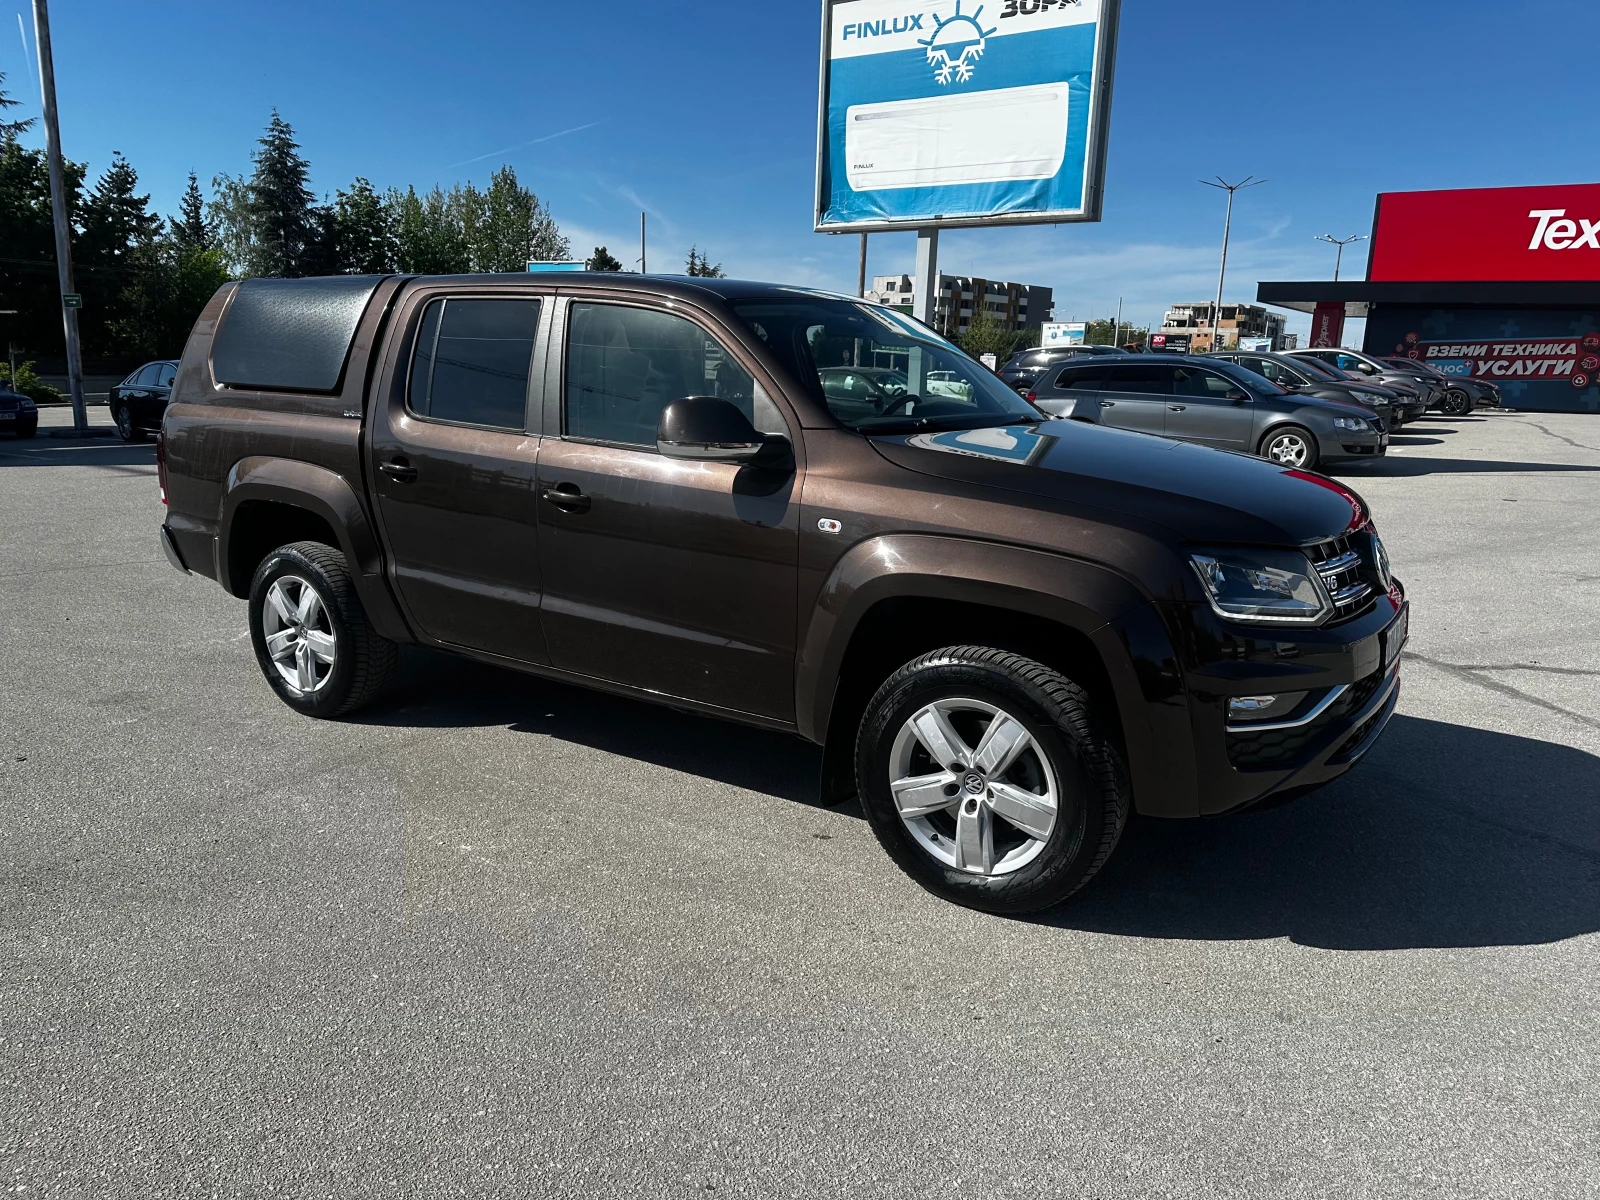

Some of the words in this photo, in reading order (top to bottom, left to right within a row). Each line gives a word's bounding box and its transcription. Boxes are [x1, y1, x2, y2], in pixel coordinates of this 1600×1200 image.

[843, 13, 924, 41] FINLUX
[1426, 344, 1488, 357] ВЗЕМИ
[1492, 343, 1577, 356] ТЕХНИКА
[1475, 359, 1576, 376] УСЛУГИ
[1322, 576, 1338, 590] V6
